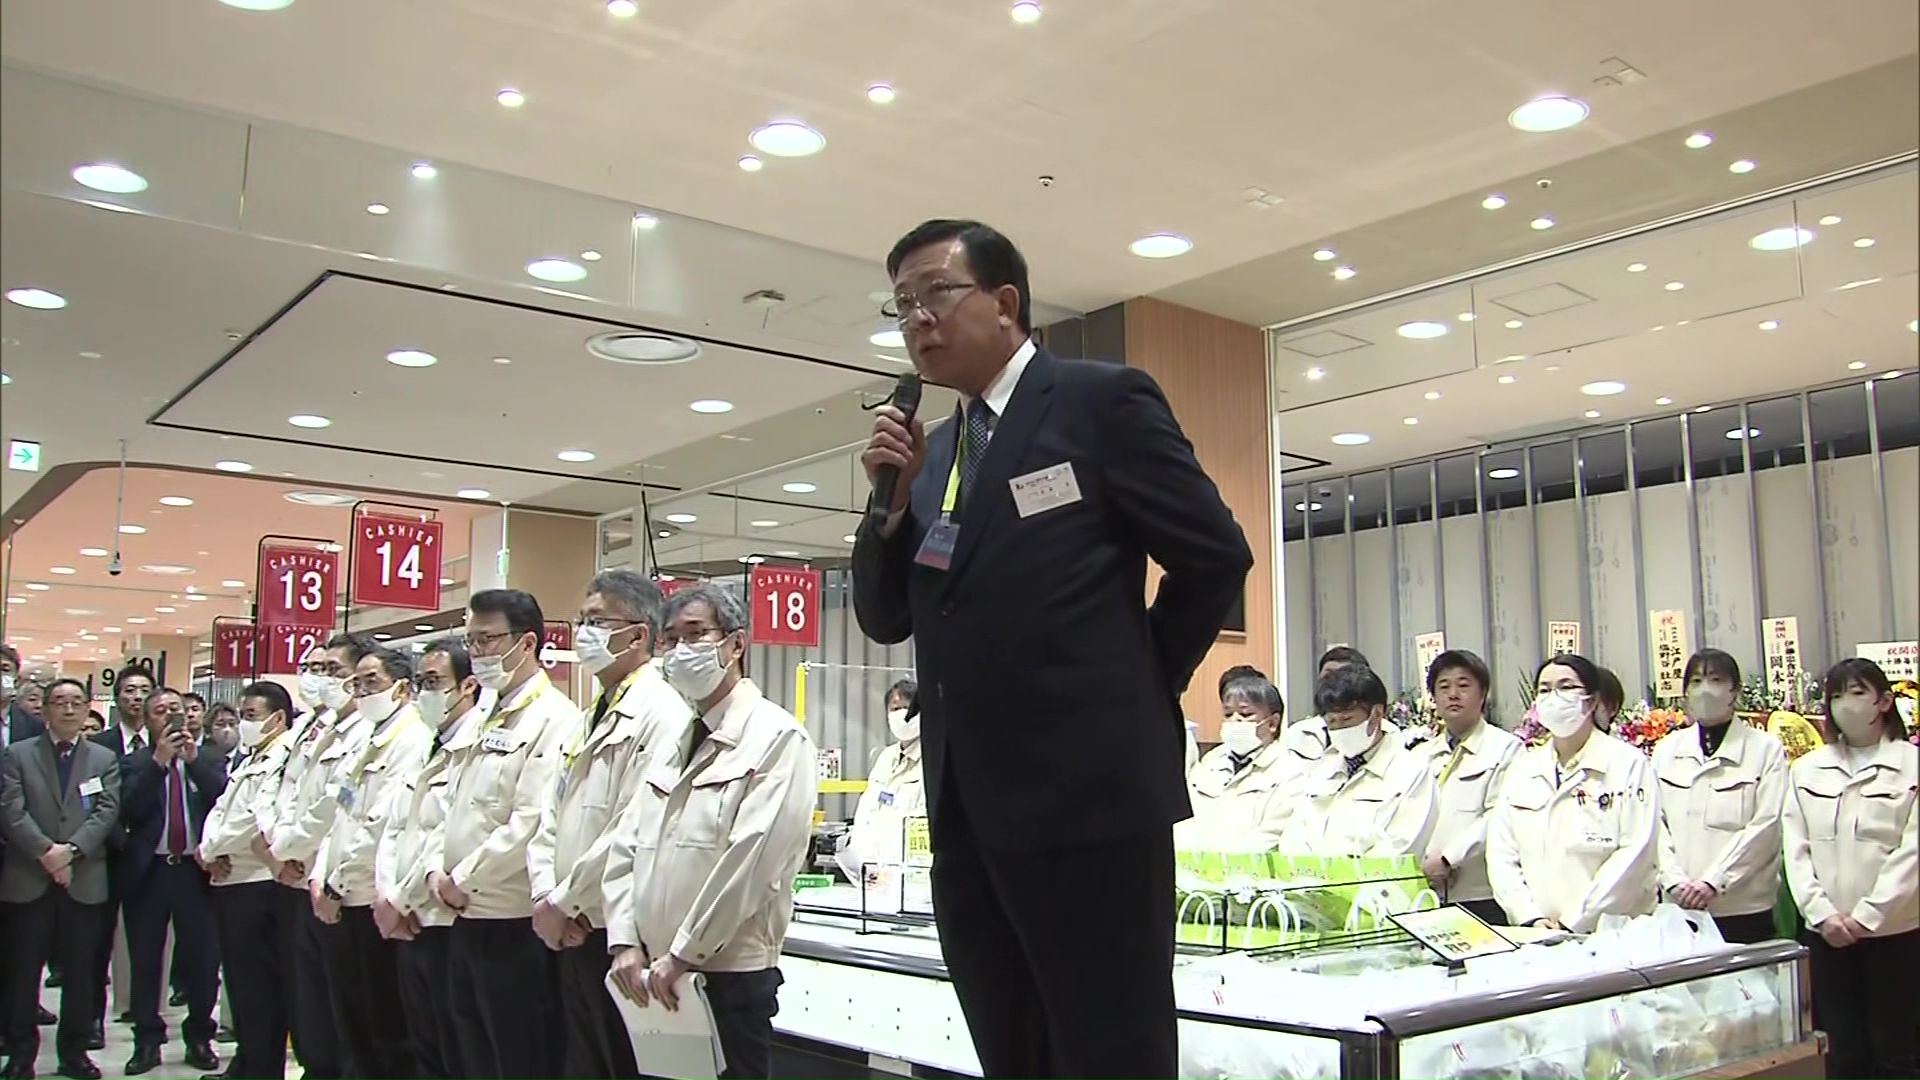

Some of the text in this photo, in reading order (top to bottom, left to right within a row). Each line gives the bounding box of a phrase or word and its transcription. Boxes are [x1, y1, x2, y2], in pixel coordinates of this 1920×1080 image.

[366, 523, 434, 547] CASHIER
[269, 555, 331, 574] CASHIER
[376, 541, 424, 589] 14
[280, 569, 323, 612] 13
[758, 574, 813, 592] CASHIER
[767, 591, 806, 632] 18
[228, 640, 255, 668] 11
[284, 633, 316, 664] 12
[102, 668, 115, 687] 9
